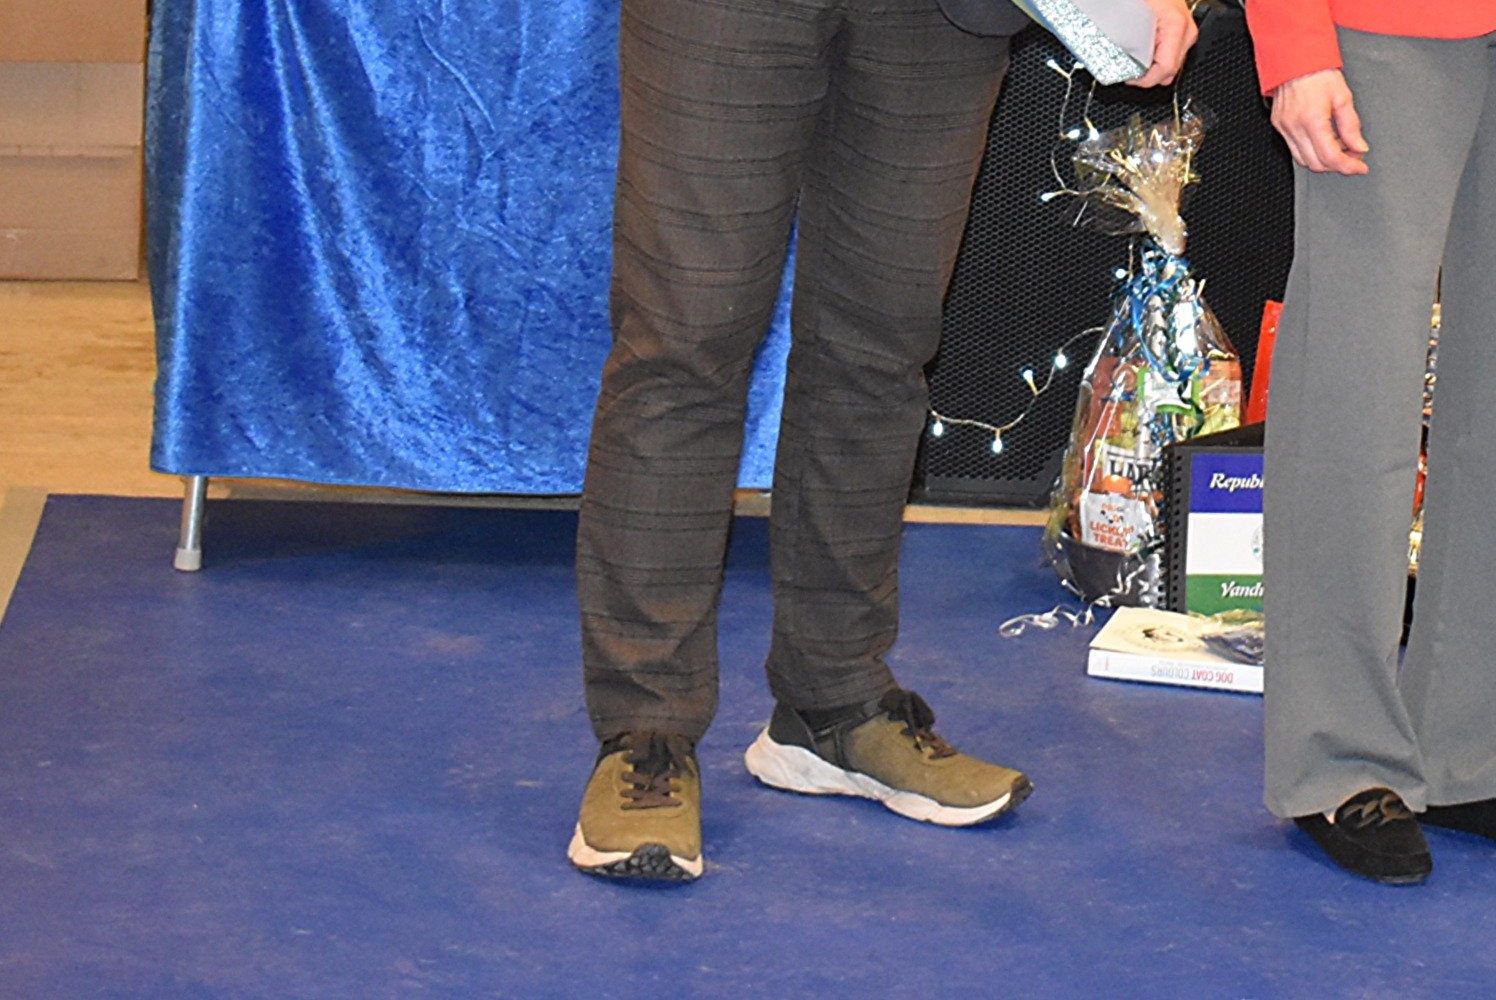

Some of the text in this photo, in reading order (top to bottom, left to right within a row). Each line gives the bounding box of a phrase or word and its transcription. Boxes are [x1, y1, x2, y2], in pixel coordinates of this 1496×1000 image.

[1210, 472, 1264, 492] Republ
[1191, 669, 1214, 682] COAT
[1215, 671, 1234, 684] DOG
